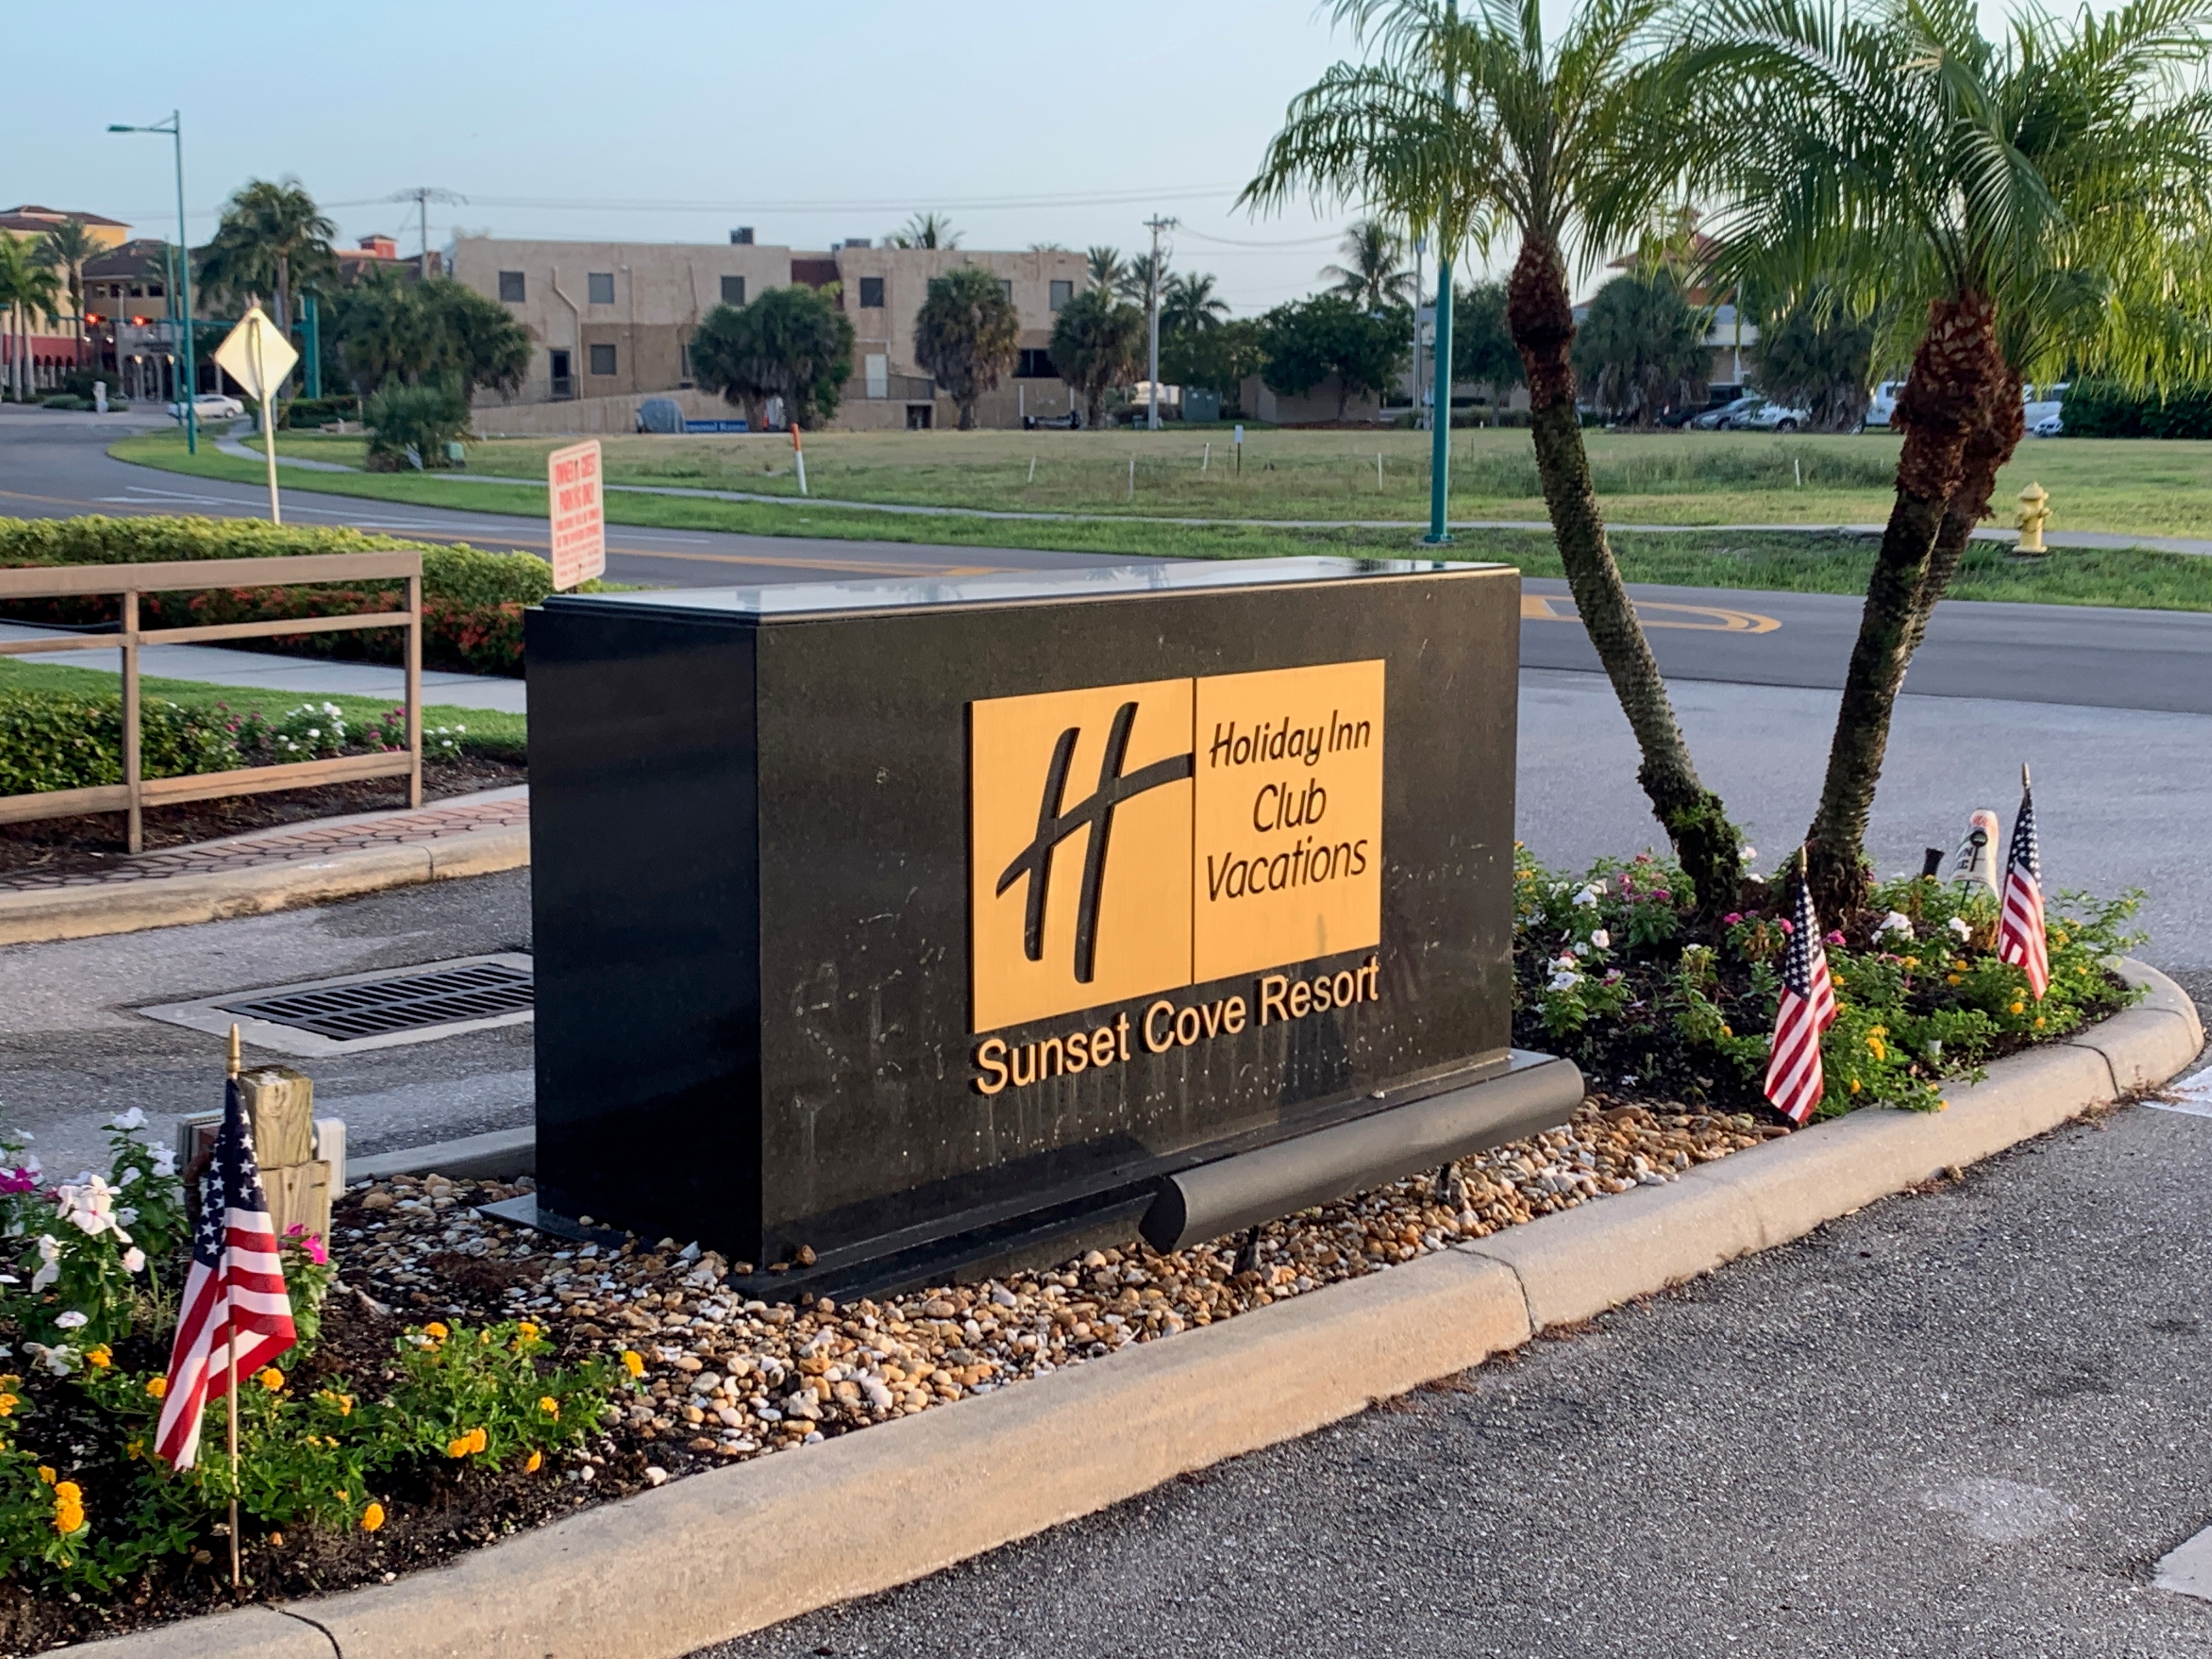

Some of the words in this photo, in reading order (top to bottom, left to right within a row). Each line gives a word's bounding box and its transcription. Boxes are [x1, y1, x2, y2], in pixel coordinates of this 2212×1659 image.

[1209, 716, 1324, 768] Holiday
[1328, 709, 1370, 752] Inn
[1253, 778, 1327, 832] Club
[1207, 836, 1368, 901] Vacations
[976, 1012, 1130, 1094] Sunset
[1144, 995, 1246, 1053] Cove
[1261, 956, 1380, 1026] Resort
